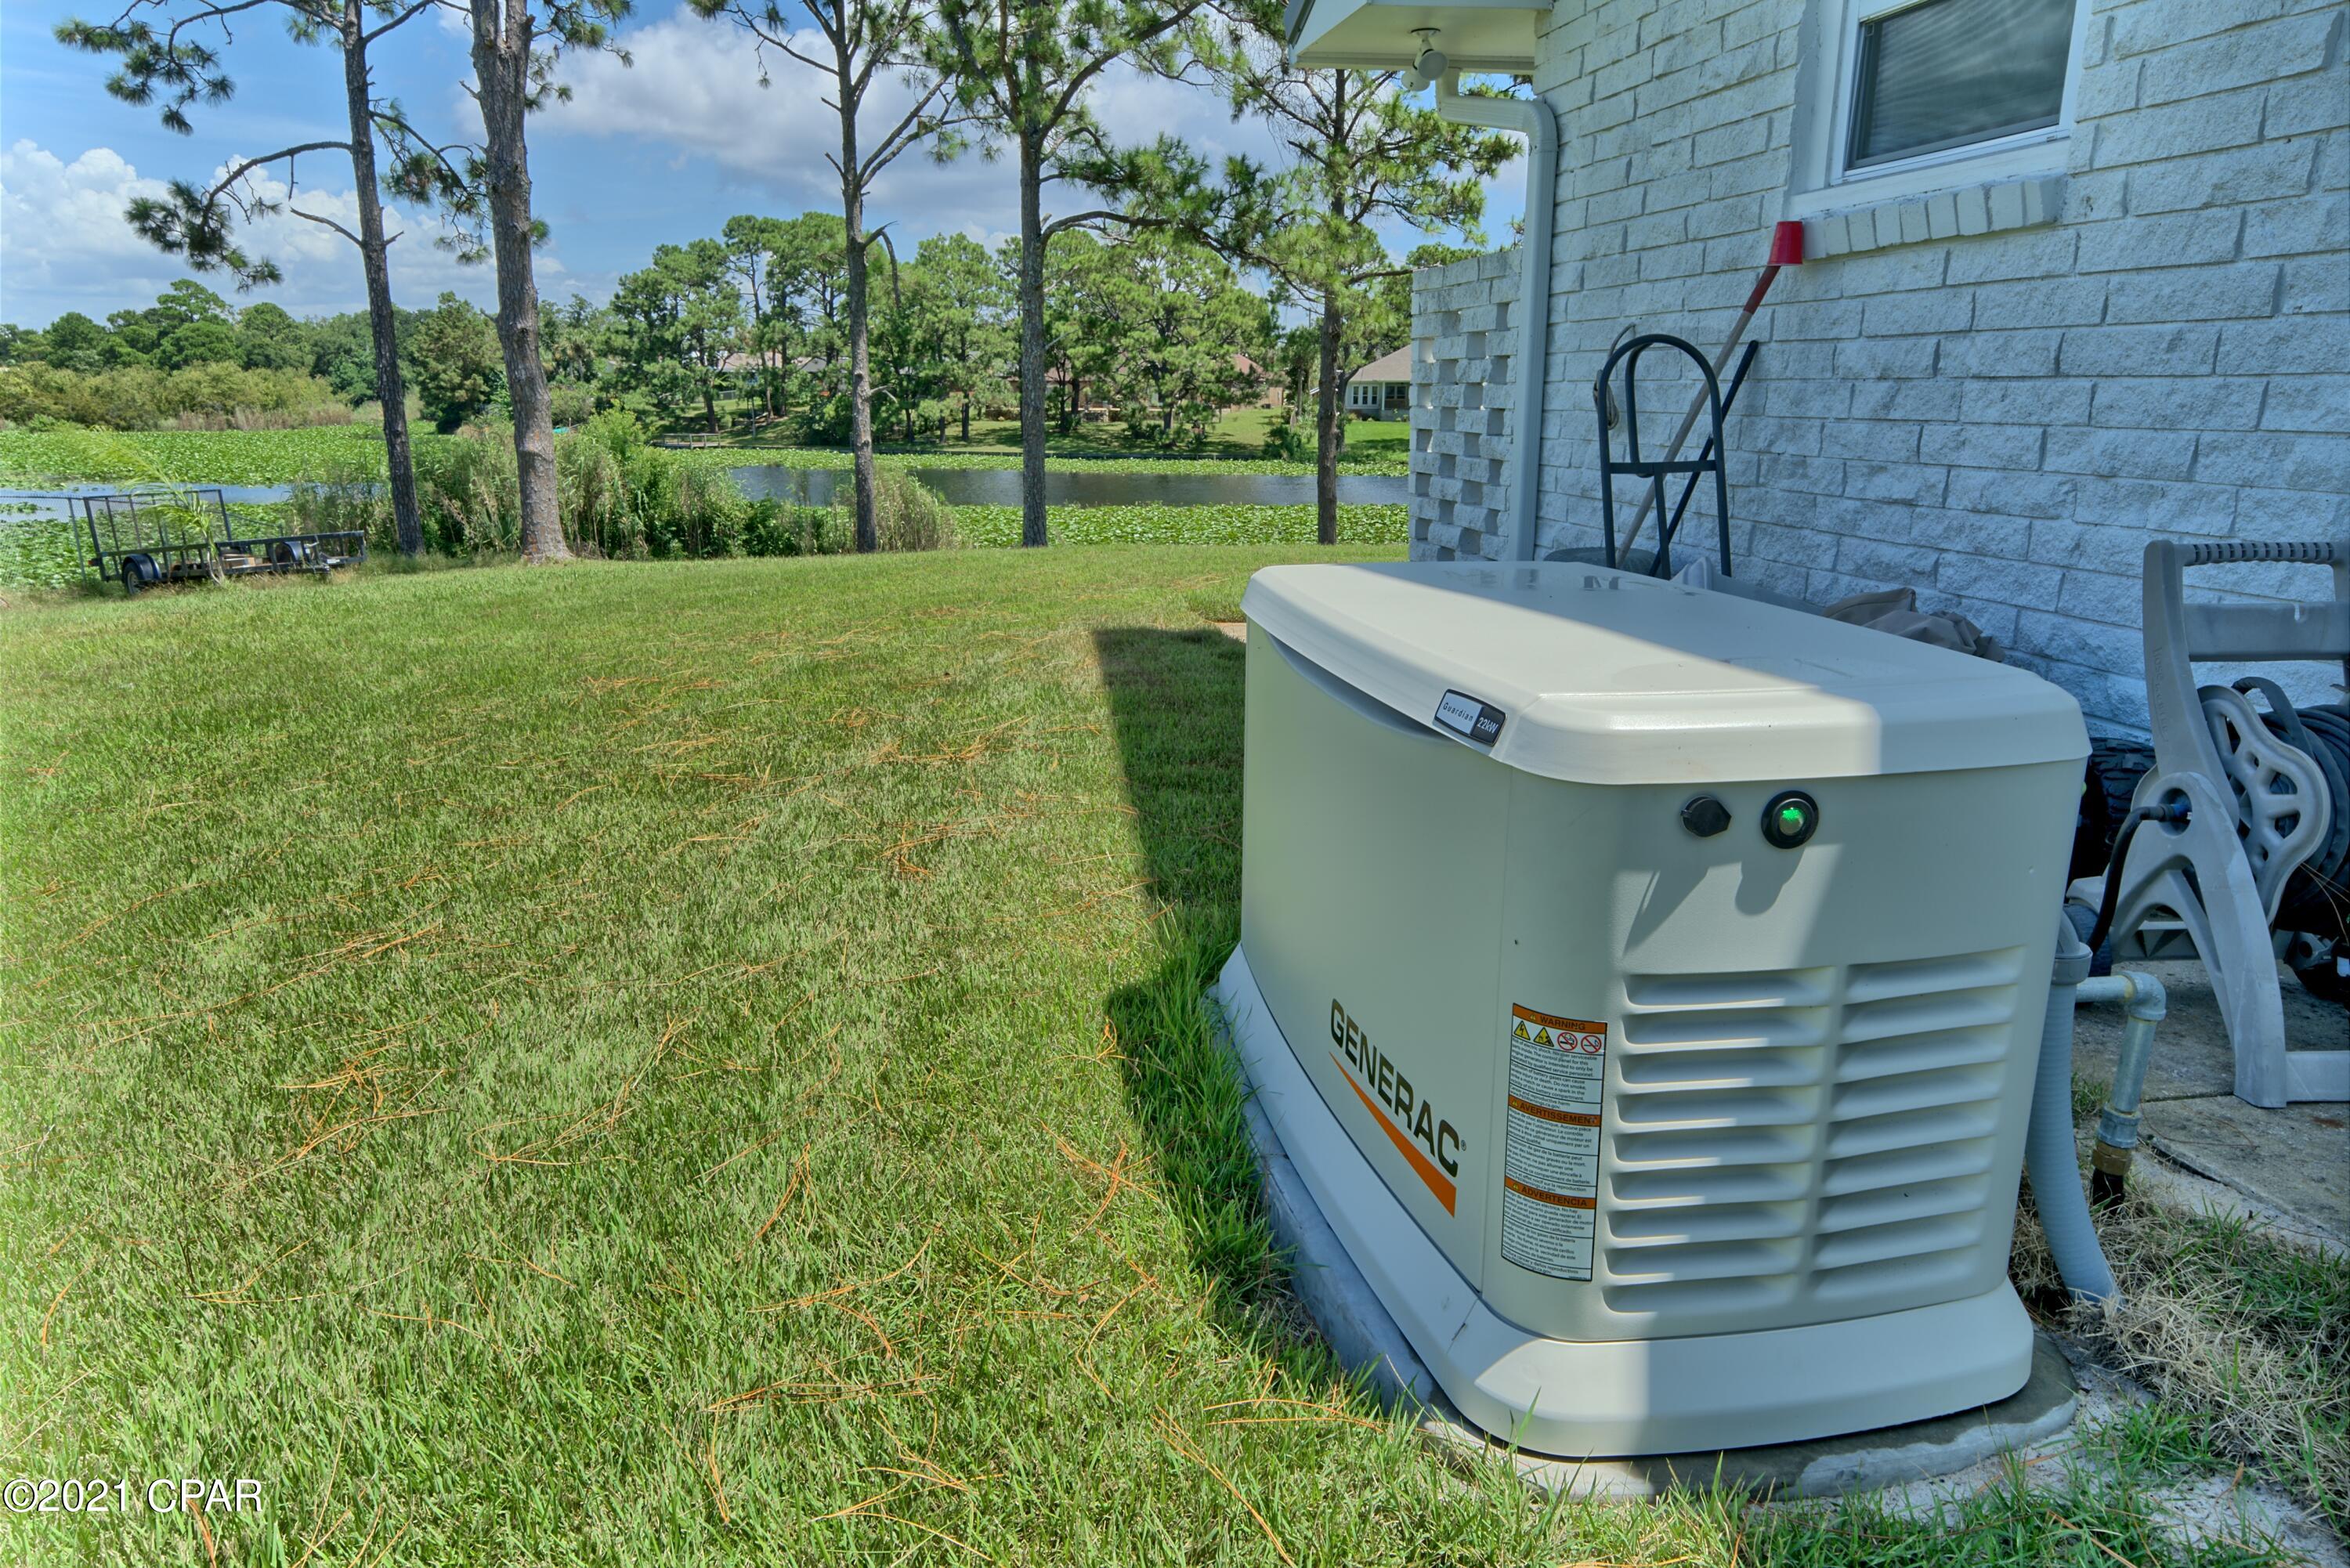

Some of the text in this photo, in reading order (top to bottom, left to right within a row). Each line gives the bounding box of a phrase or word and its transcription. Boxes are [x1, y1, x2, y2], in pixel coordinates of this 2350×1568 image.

[1443, 702, 1473, 721] Guardian
[1477, 717, 1499, 733] 22kW
[1540, 1016, 1585, 1030] WARNING
[1521, 1187, 1587, 1206] ADVERTENCIA
